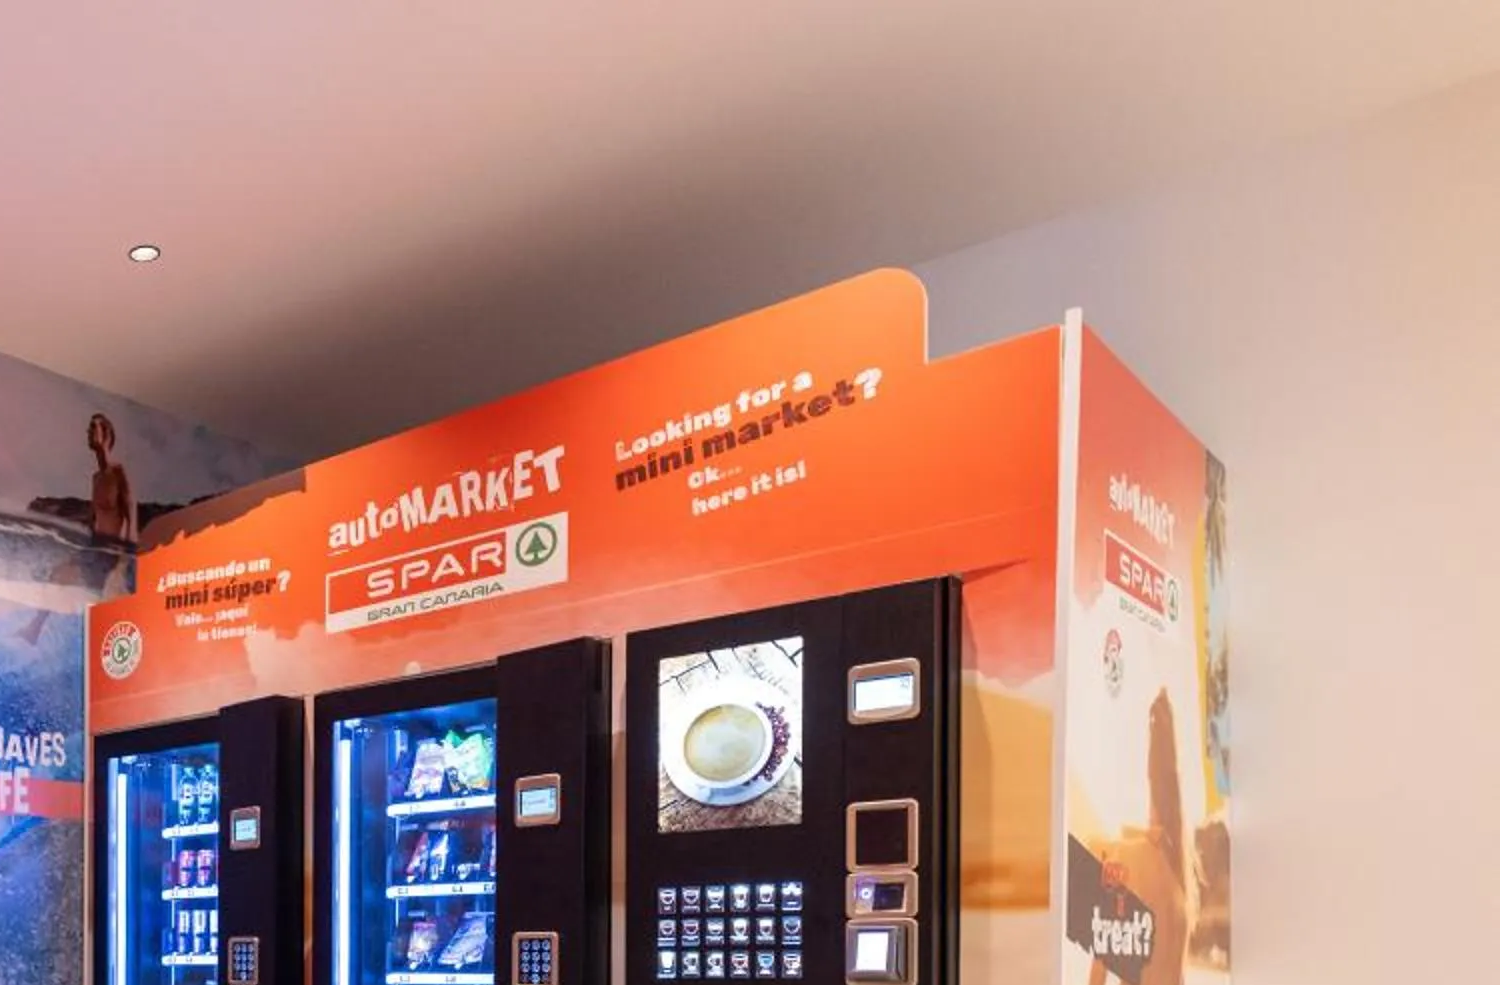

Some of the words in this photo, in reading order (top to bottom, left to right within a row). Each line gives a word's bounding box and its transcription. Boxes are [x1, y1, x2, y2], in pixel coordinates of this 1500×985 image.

[615, 403, 731, 461] Looking
[736, 381, 787, 413] for
[792, 371, 813, 392] a
[615, 437, 694, 491] mini
[702, 367, 882, 460] market?
[691, 485, 749, 516] here
[751, 473, 773, 495] it
[775, 460, 807, 487] is!
[156, 560, 246, 593] ¿Buscando
[248, 557, 272, 573] un
[165, 583, 209, 610] mini
[213, 569, 291, 603] súper?
[367, 541, 504, 598] SPAR
[1119, 551, 1165, 602] SPAR
[367, 601, 416, 622] GRAN
[419, 581, 505, 610] CANARIA
[1092, 905, 1153, 956] treat?
